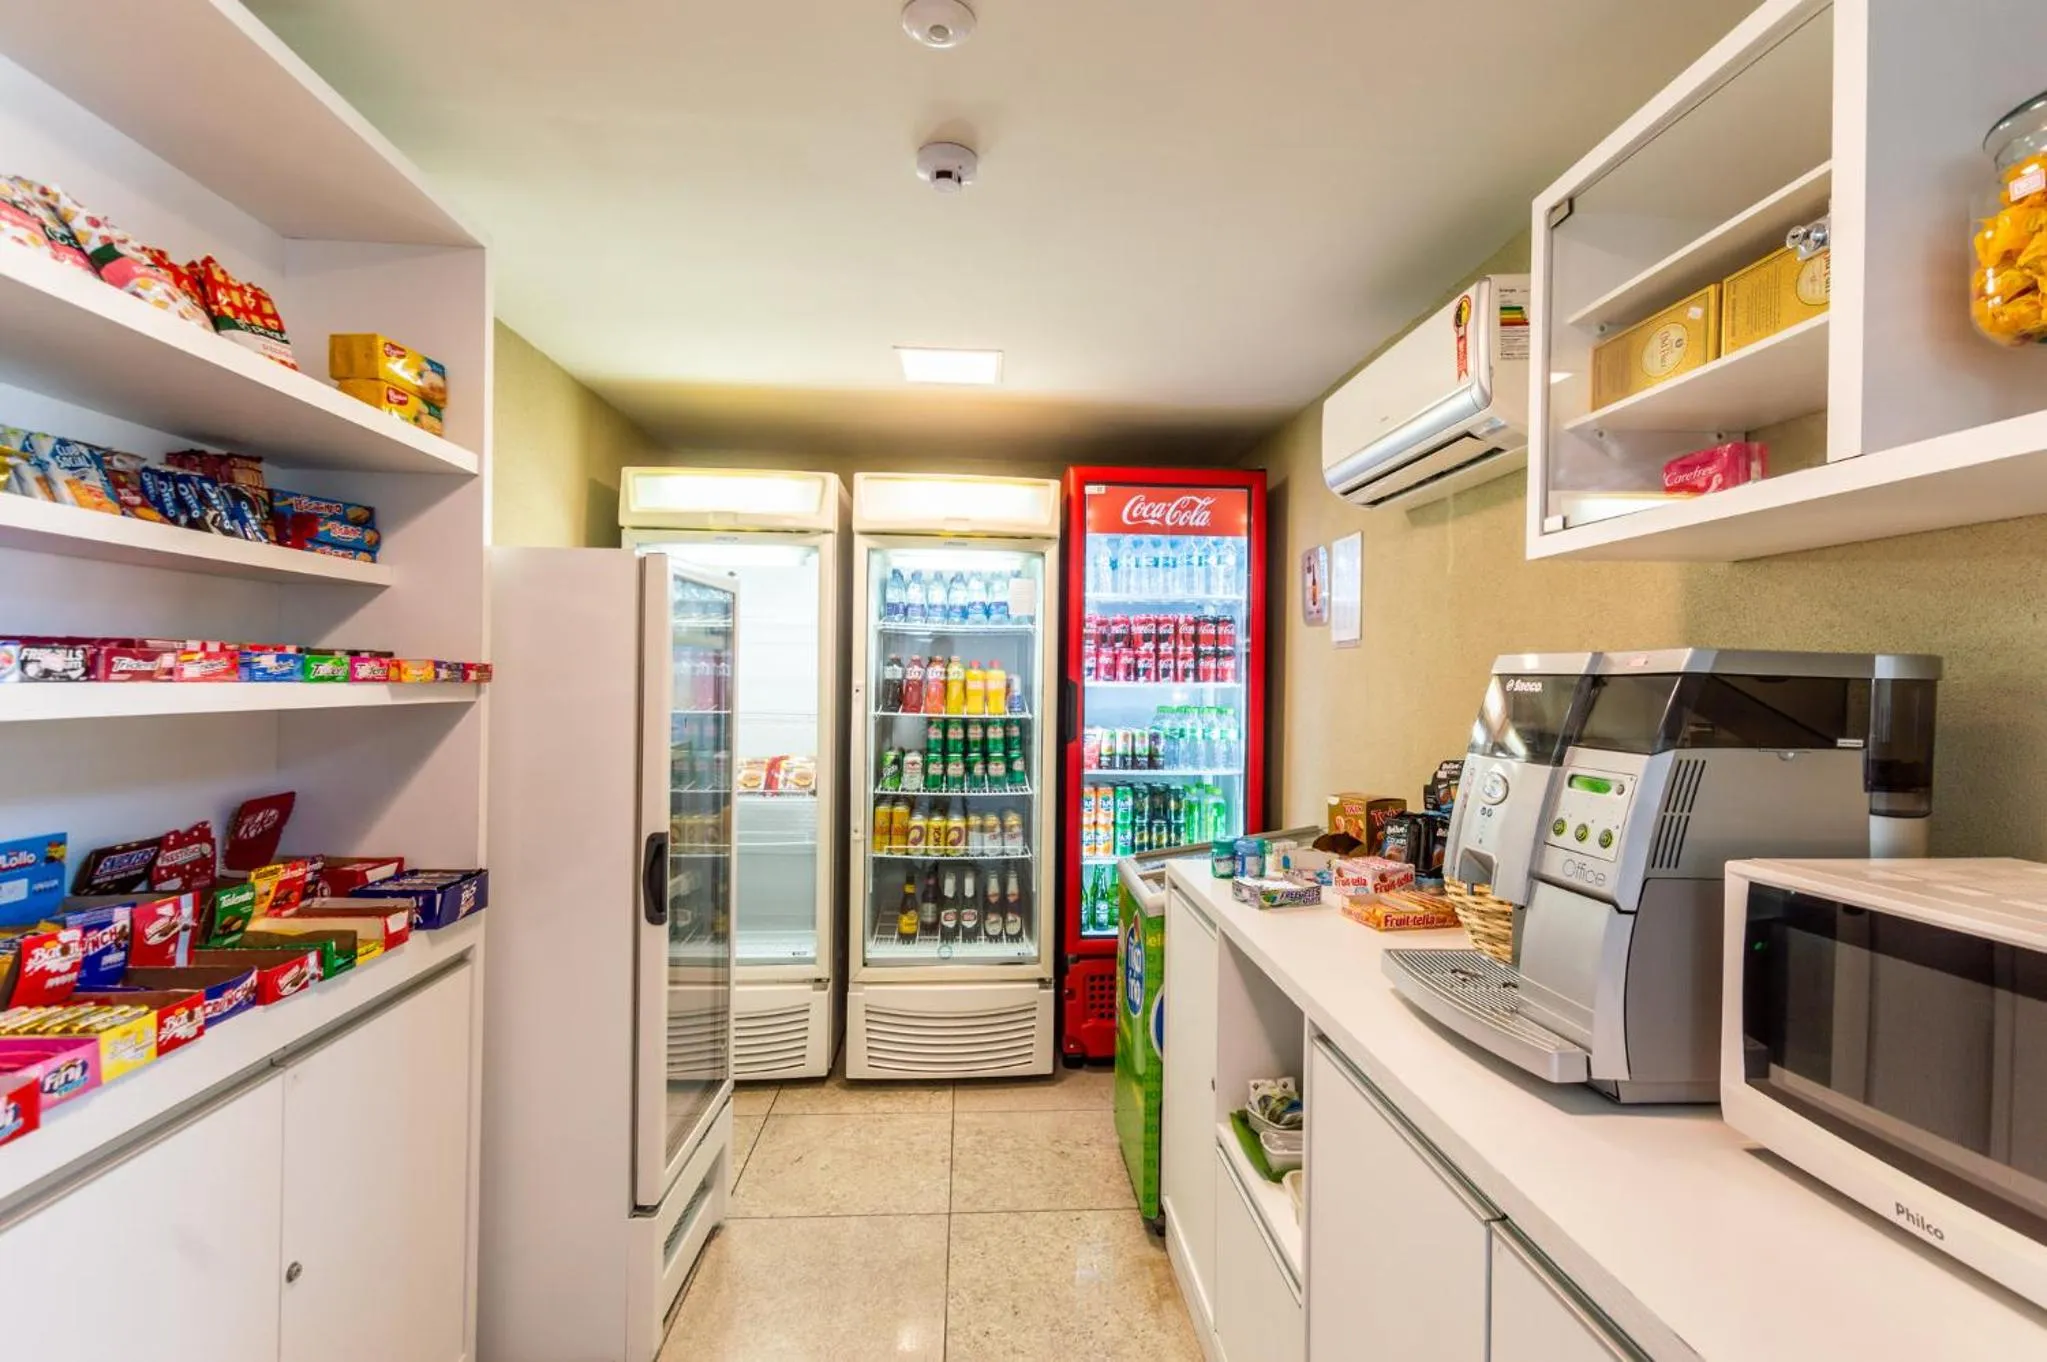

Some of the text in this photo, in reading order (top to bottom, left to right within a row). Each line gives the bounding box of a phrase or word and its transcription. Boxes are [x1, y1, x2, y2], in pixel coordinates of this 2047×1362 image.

[1663, 464, 1718, 488] Carefree
[1121, 494, 1217, 528] Coca-Cola
[111, 656, 158, 672] Trident
[1513, 680, 1543, 692] Saeco
[1562, 858, 1607, 887] Office
[220, 891, 255, 909] Talento
[1384, 914, 1436, 927] Fruit-tella
[42, 1058, 87, 1092] Fini
[1895, 1202, 1945, 1241] Philco
